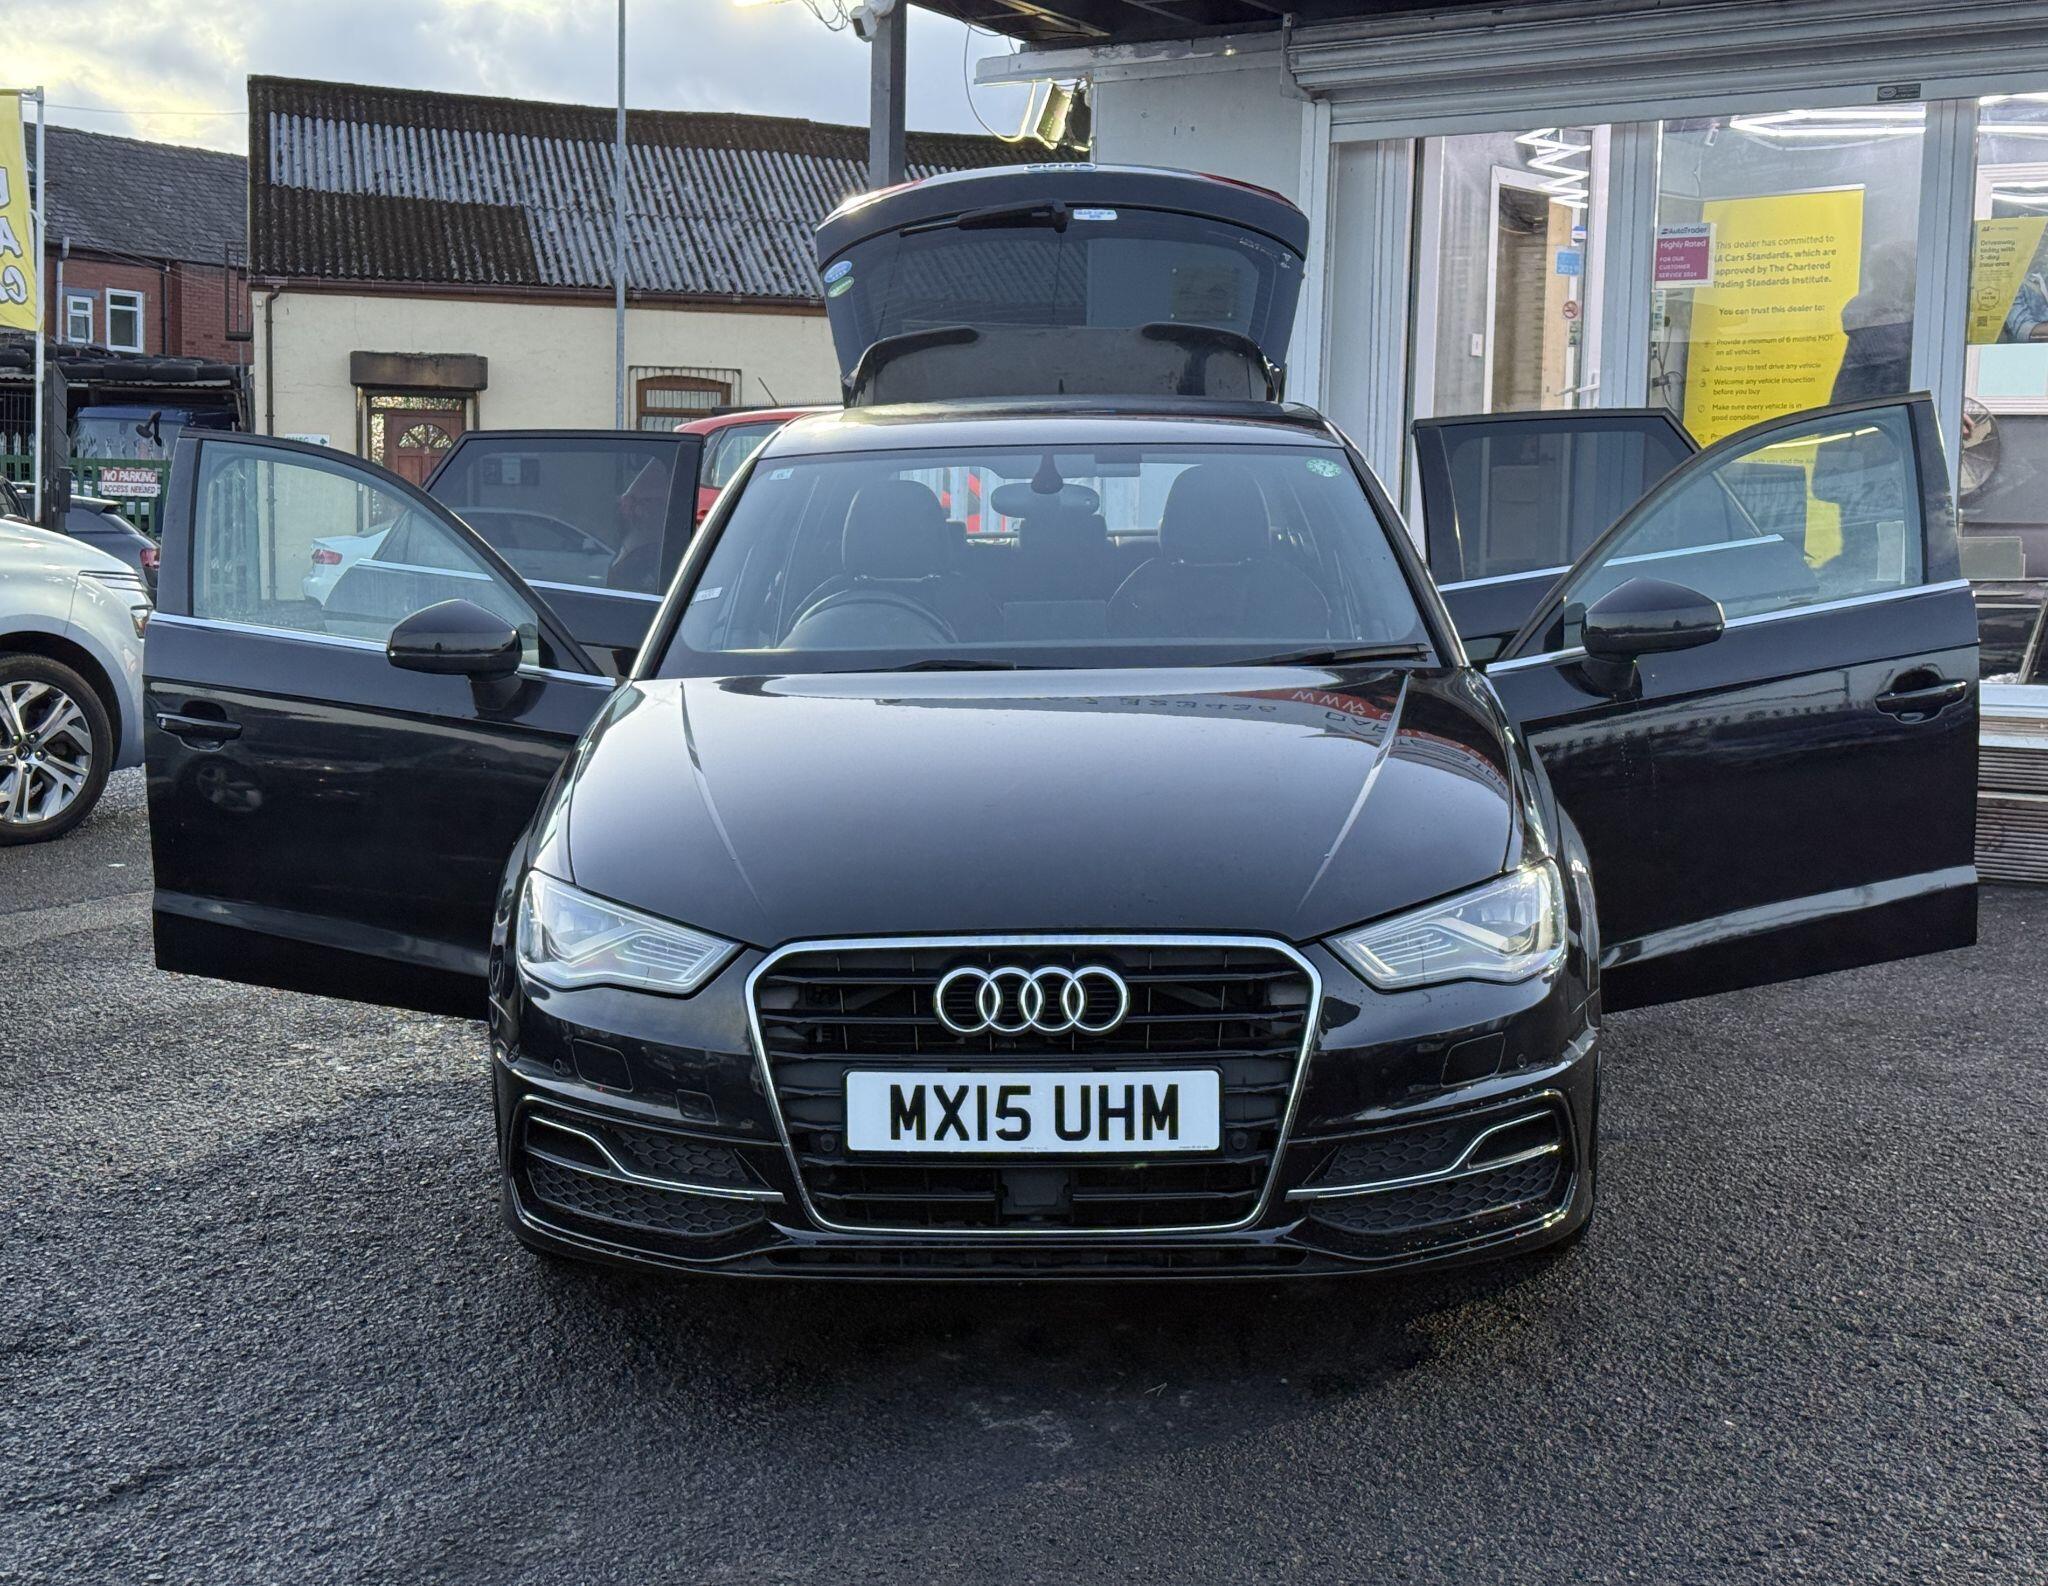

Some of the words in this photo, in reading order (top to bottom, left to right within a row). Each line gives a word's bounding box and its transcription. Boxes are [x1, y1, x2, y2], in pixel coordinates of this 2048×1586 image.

[1661, 241, 1683, 250] Highly
[1684, 239, 1707, 248] Rated
[1716, 241, 1731, 249] This
[1734, 239, 1759, 248] dealer
[1762, 239, 1776, 247] has
[1778, 236, 1824, 245] committed
[1825, 235, 1835, 243] to
[1725, 253, 1744, 262] Cars
[1795, 249, 1820, 258] which
[1714, 266, 1755, 276] approved
[1757, 265, 1767, 274] by
[1769, 264, 1784, 272] The
[1787, 262, 1831, 271] Chartered
[1713, 280, 1744, 289] Trading
[1746, 278, 1790, 287] Standards
[1751, 306, 1769, 314] trust
[1771, 305, 1785, 313] this
[1787, 304, 1812, 312] dealer
[1716, 338, 1741, 346] Provide
[1792, 335, 1817, 343] months
[1818, 334, 1833, 342] MOT
[1755, 363, 1767, 371] test
[1786, 363, 1797, 371] any
[1782, 376, 1816, 384] inspection
[1749, 388, 1761, 396] buy
[1730, 413, 1760, 421] condition
[103, 470, 117, 481] NO
[119, 470, 156, 482] PARKING
[104, 484, 129, 493] ACCESS
[130, 485, 156, 494] NEEDED
[890, 1084, 1031, 1141] MX15
[1054, 1083, 1178, 1141] UHM
